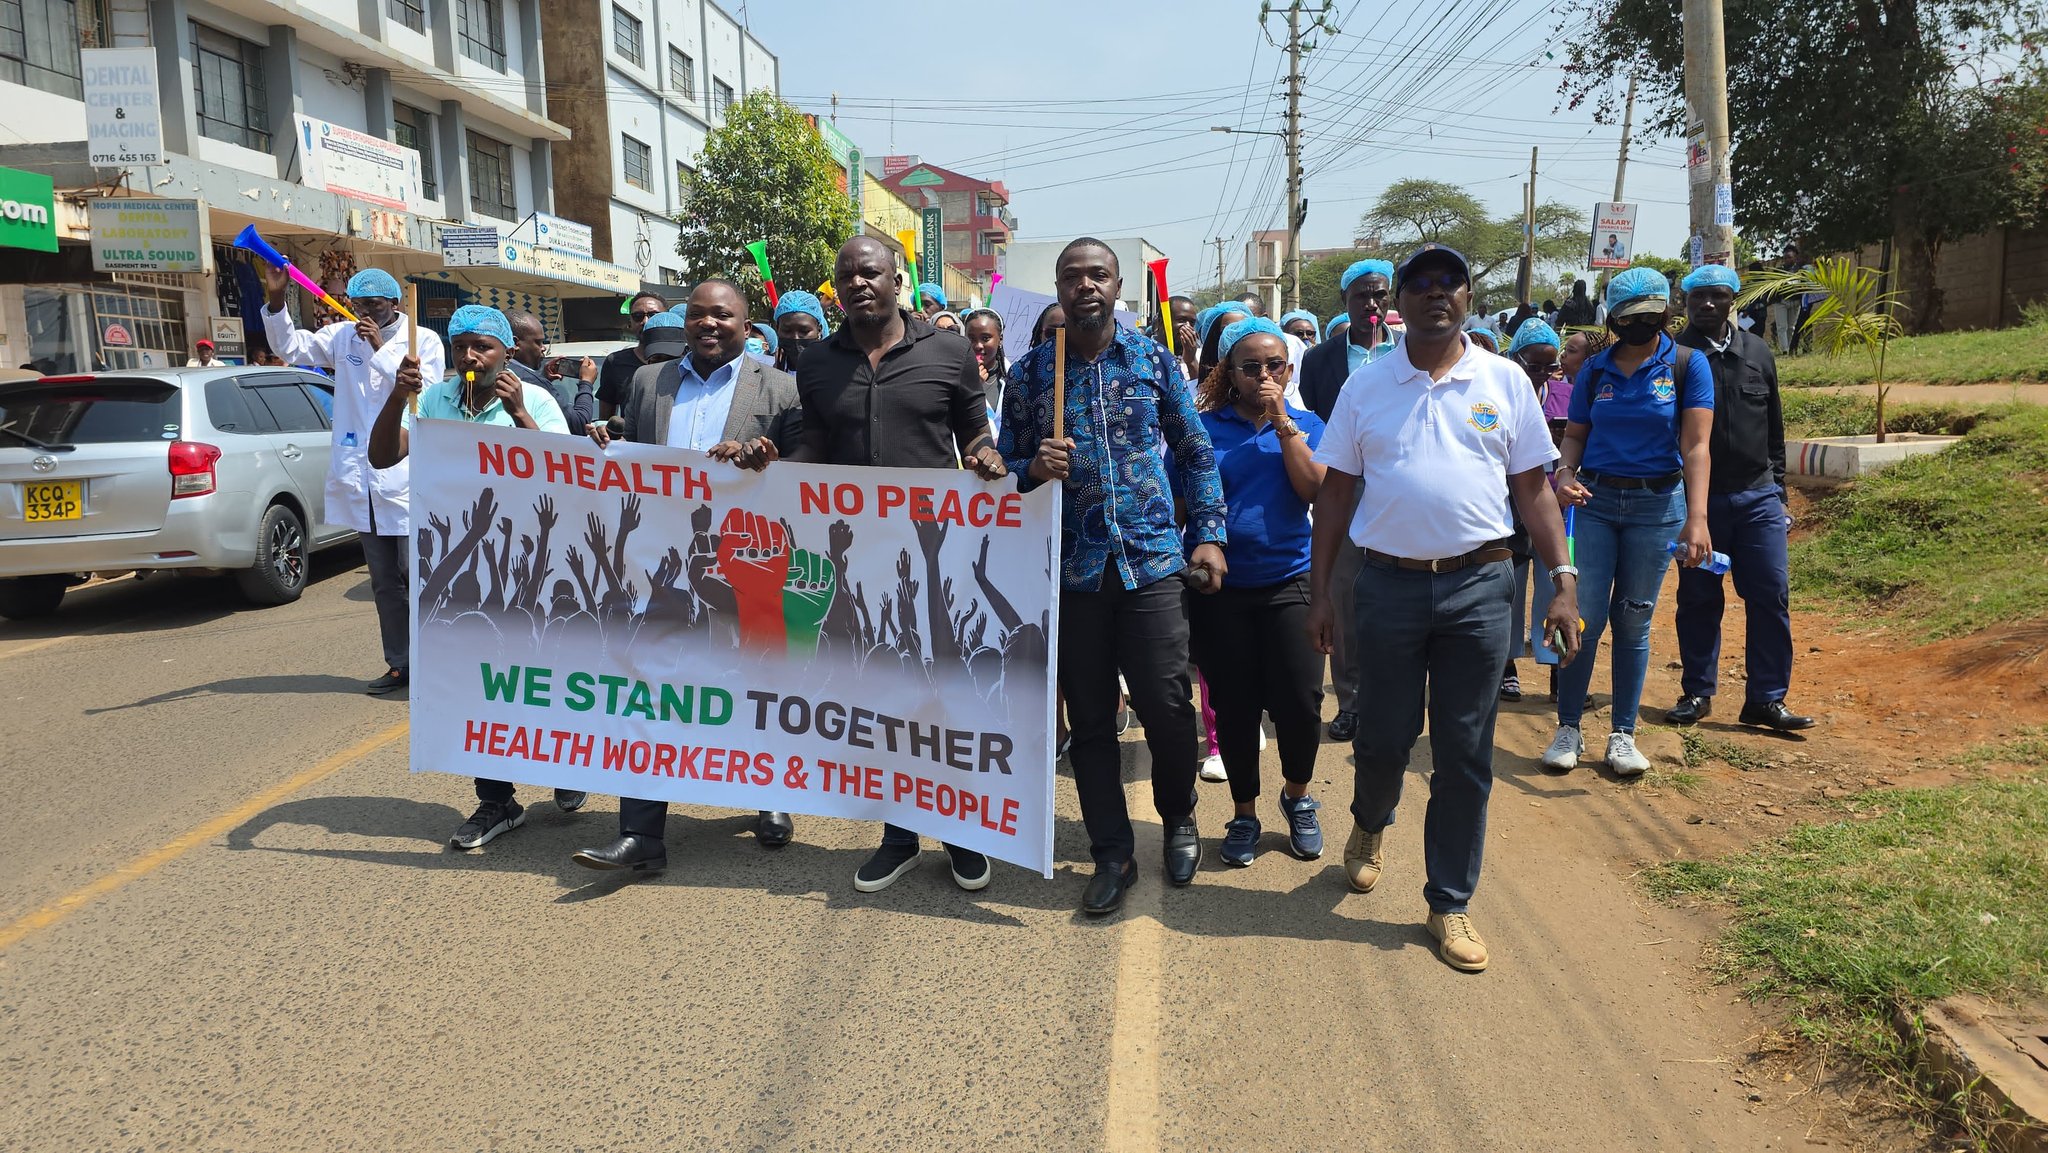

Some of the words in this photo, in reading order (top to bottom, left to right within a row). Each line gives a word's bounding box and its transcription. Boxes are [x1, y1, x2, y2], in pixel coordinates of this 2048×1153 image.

[85, 65, 152, 86] DENTAL
[87, 92, 154, 107] CENTER
[115, 107, 126, 120] &
[89, 122, 157, 139] IMAGING
[92, 154, 116, 163] 0716
[118, 154, 138, 162] 455
[139, 153, 157, 162] 163
[93, 202, 121, 210] NOPRI
[123, 202, 162, 210] MEDICAL
[164, 202, 198, 210] CENTRE
[118, 212, 169, 225] DENTAL
[926, 213, 935, 239] BANK
[1600, 218, 1631, 226] SALARY
[101, 227, 189, 239] LABORATORY
[102, 249, 145, 261] ULTRA
[148, 250, 196, 261] SOUND
[926, 240, 935, 284] KINGDOM
[523, 251, 541, 268] Kenya
[576, 263, 596, 278] Traders
[478, 441, 535, 479] NO
[544, 450, 713, 501] HEALTH
[27, 485, 64, 503] KCQ
[28, 501, 76, 520] 334P
[800, 481, 864, 516] NO
[878, 485, 1022, 528] PEACE
[481, 663, 552, 706] WE
[566, 672, 733, 725] STAND
[747, 690, 1014, 775] TOGETHER
[465, 720, 595, 767] HEALTH
[603, 737, 774, 785] WORKERS
[783, 755, 809, 789] &
[818, 759, 883, 800] THE
[893, 772, 1019, 835] PEOPLE
